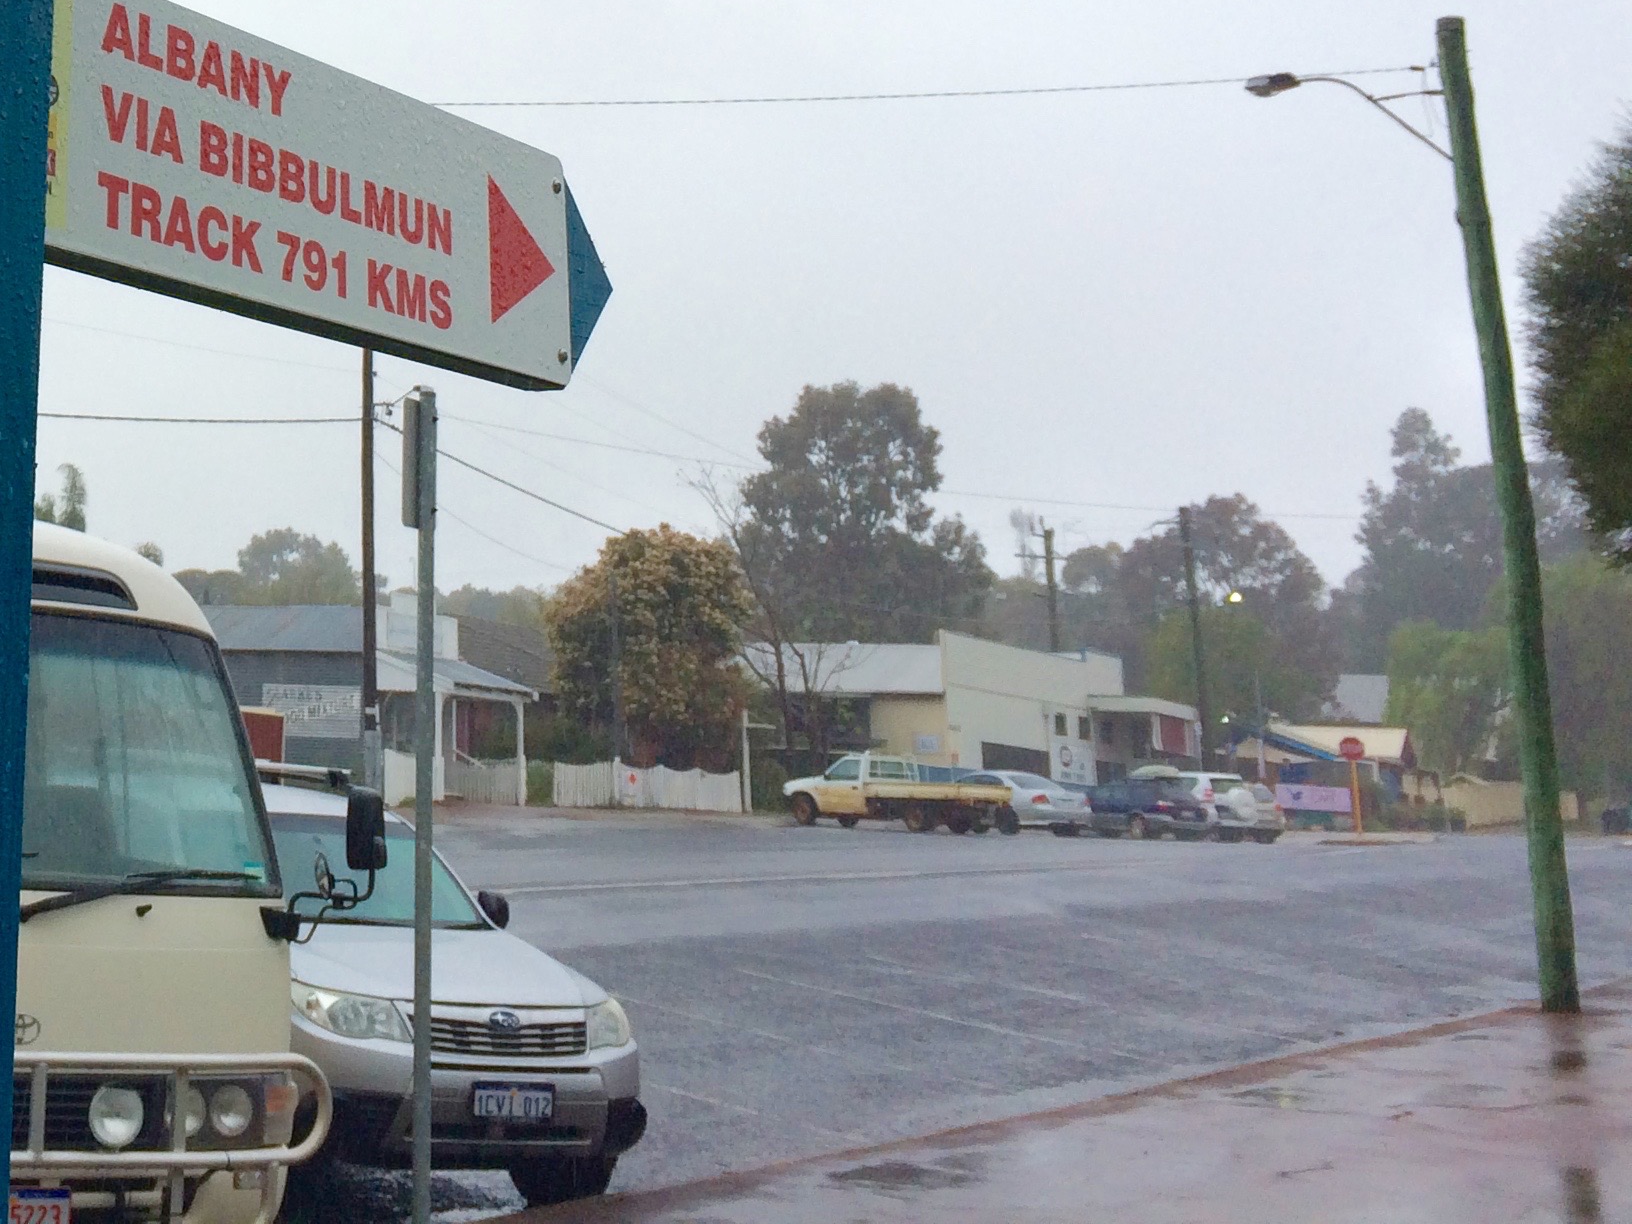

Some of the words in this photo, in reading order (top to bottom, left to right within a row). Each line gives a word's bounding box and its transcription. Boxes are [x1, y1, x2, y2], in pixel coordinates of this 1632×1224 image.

[102, 4, 291, 116] ALBANY
[102, 85, 182, 163] VIA
[200, 121, 452, 254] BIBBULMUN
[98, 172, 262, 273] TRACK
[277, 232, 347, 297] 791
[368, 259, 453, 329] KMS
